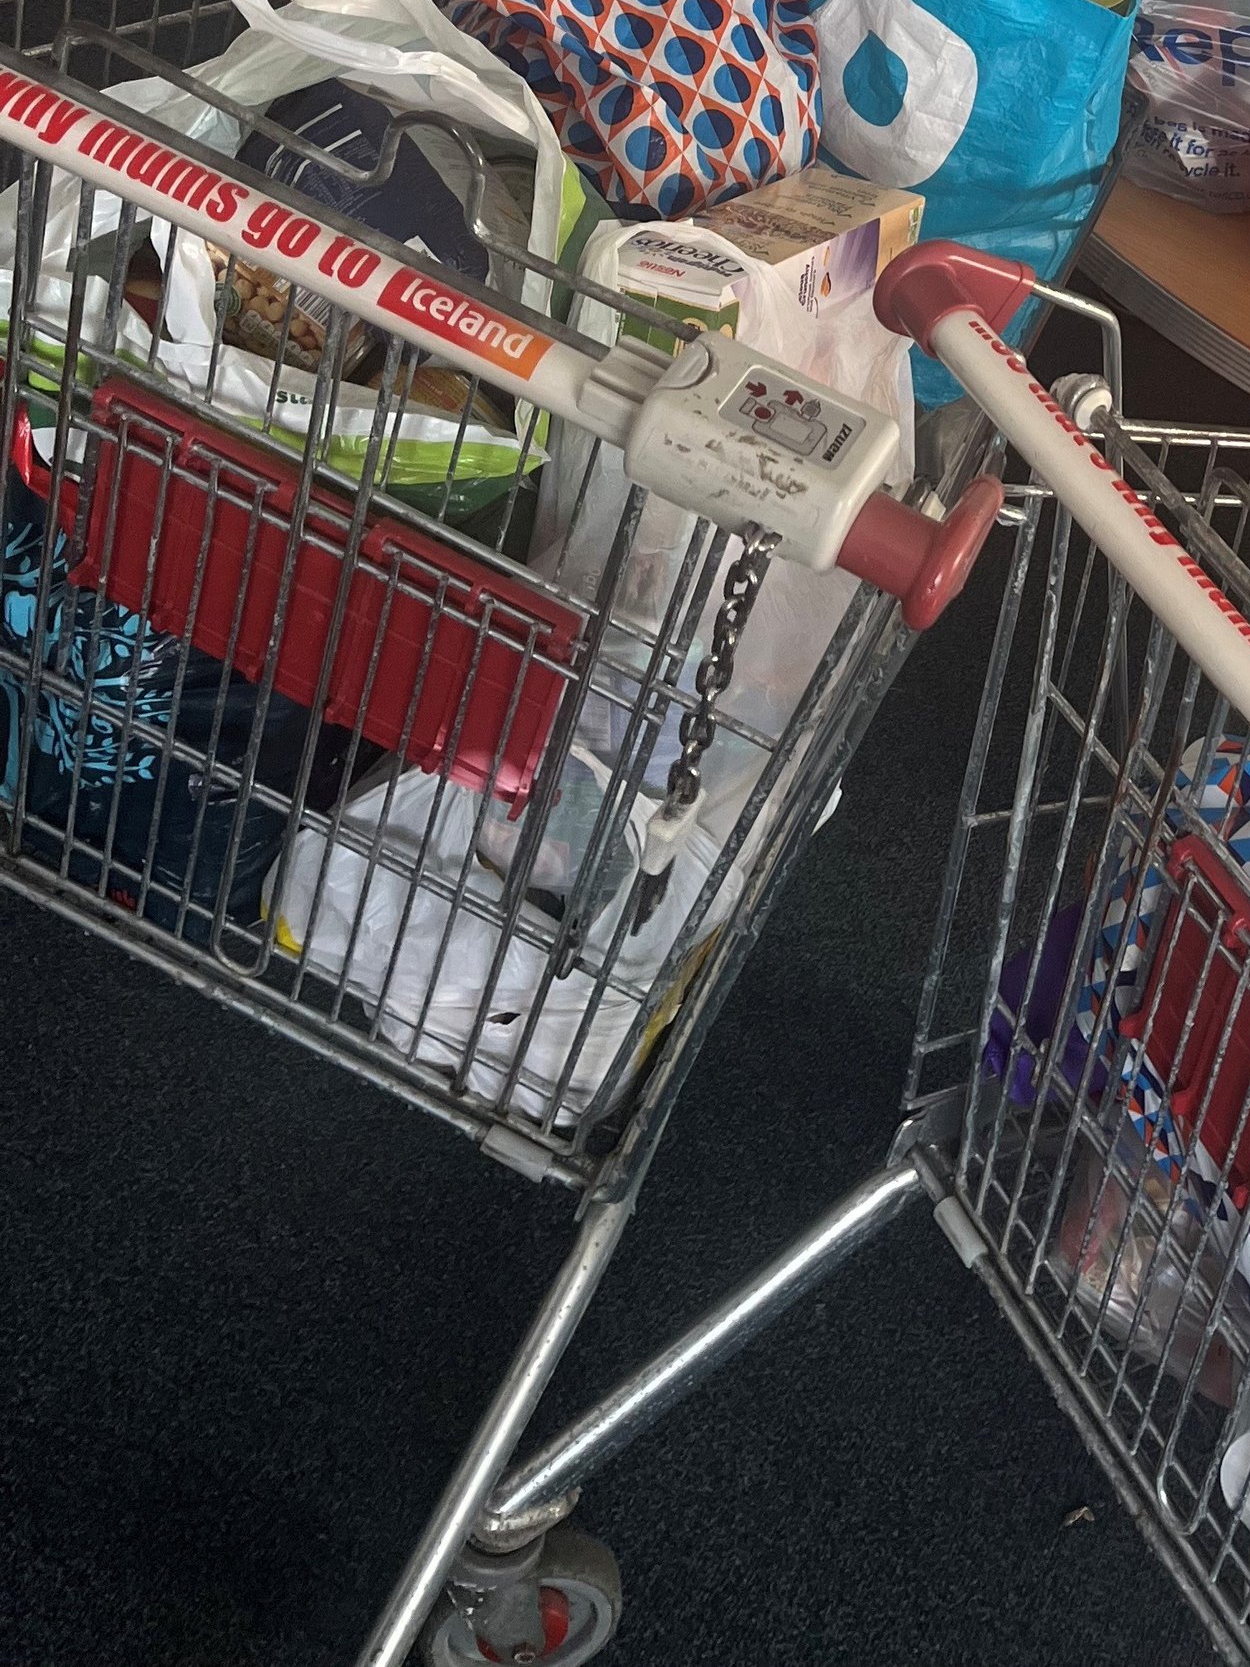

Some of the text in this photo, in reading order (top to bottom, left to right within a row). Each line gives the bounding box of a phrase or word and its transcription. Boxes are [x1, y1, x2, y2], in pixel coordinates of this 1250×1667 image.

[1186, 139, 1213, 158] for
[78, 119, 249, 223] mums
[241, 200, 323, 259] go
[318, 235, 381, 289] to
[400, 277, 535, 360] Iceland
[632, 238, 745, 275] Cheerios
